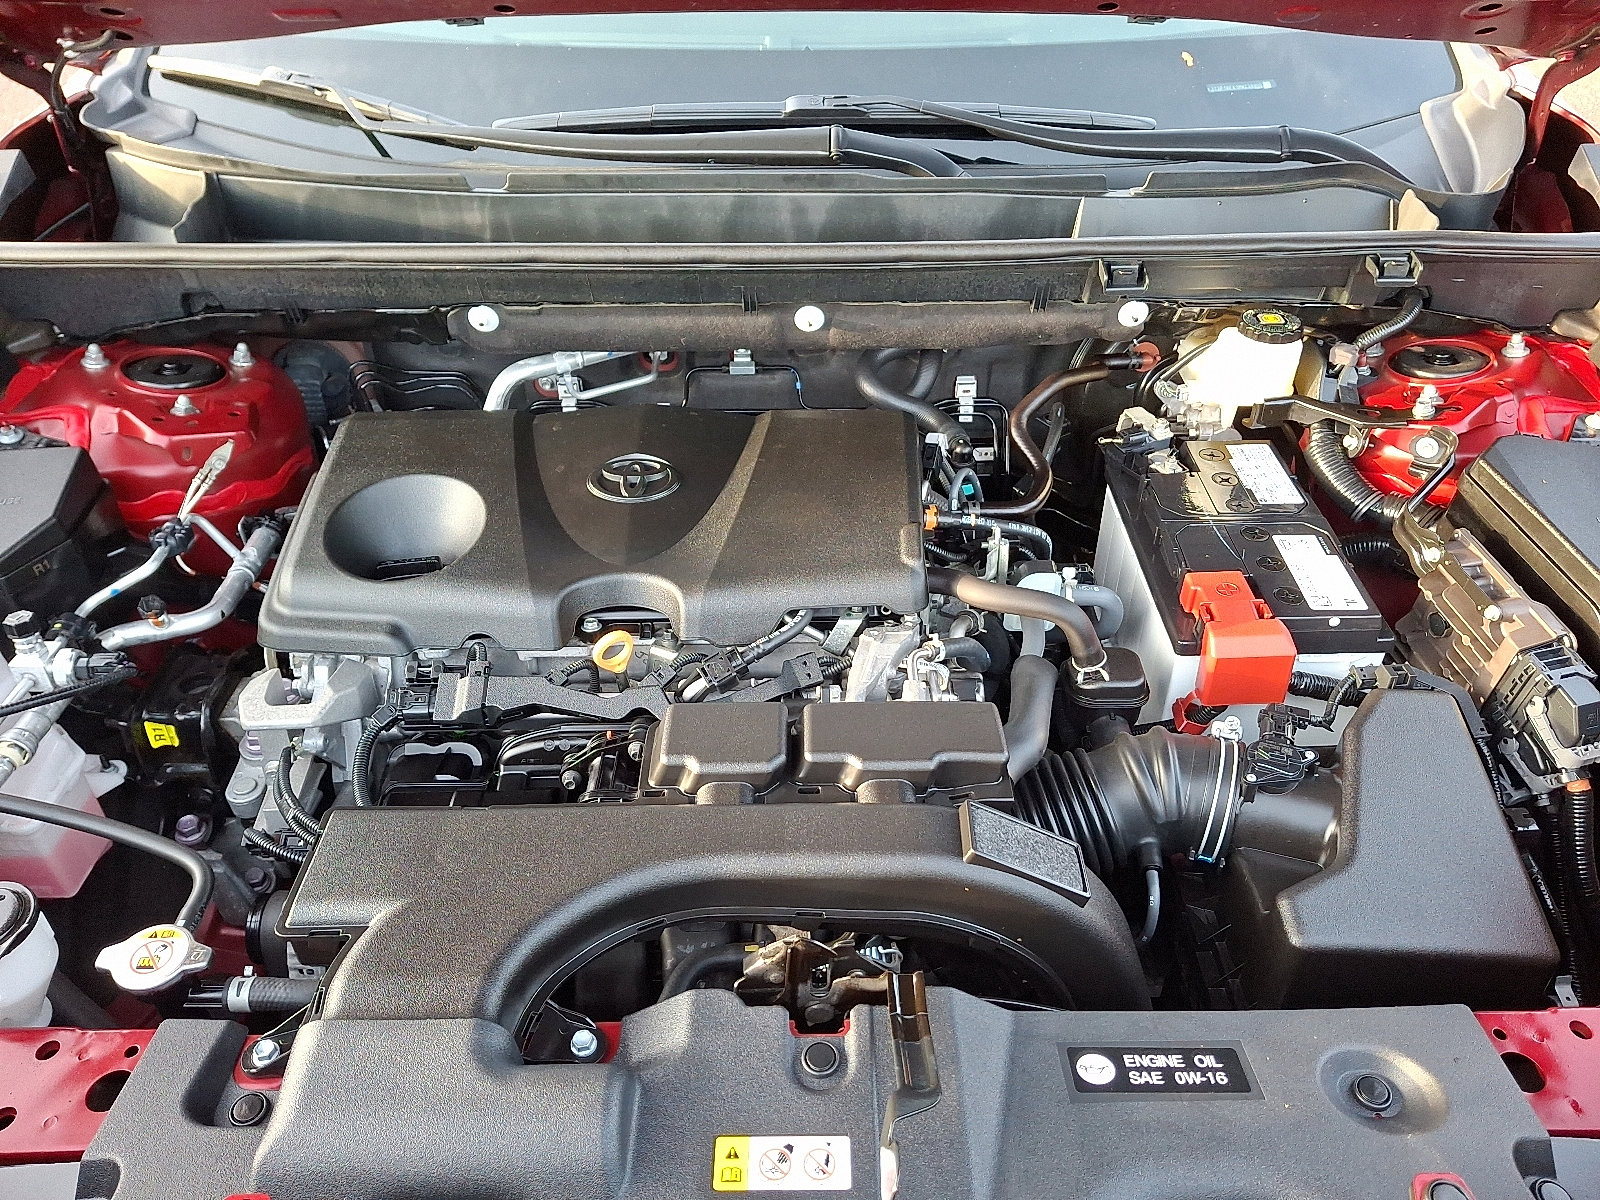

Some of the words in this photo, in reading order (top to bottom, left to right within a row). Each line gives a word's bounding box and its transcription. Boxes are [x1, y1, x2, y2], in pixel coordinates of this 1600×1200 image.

[1122, 1054, 1186, 1068] ENGINE
[1193, 1054, 1224, 1068] OIL
[1129, 1071, 1165, 1085] SAE
[1174, 1071, 1229, 1085] 0W-16
